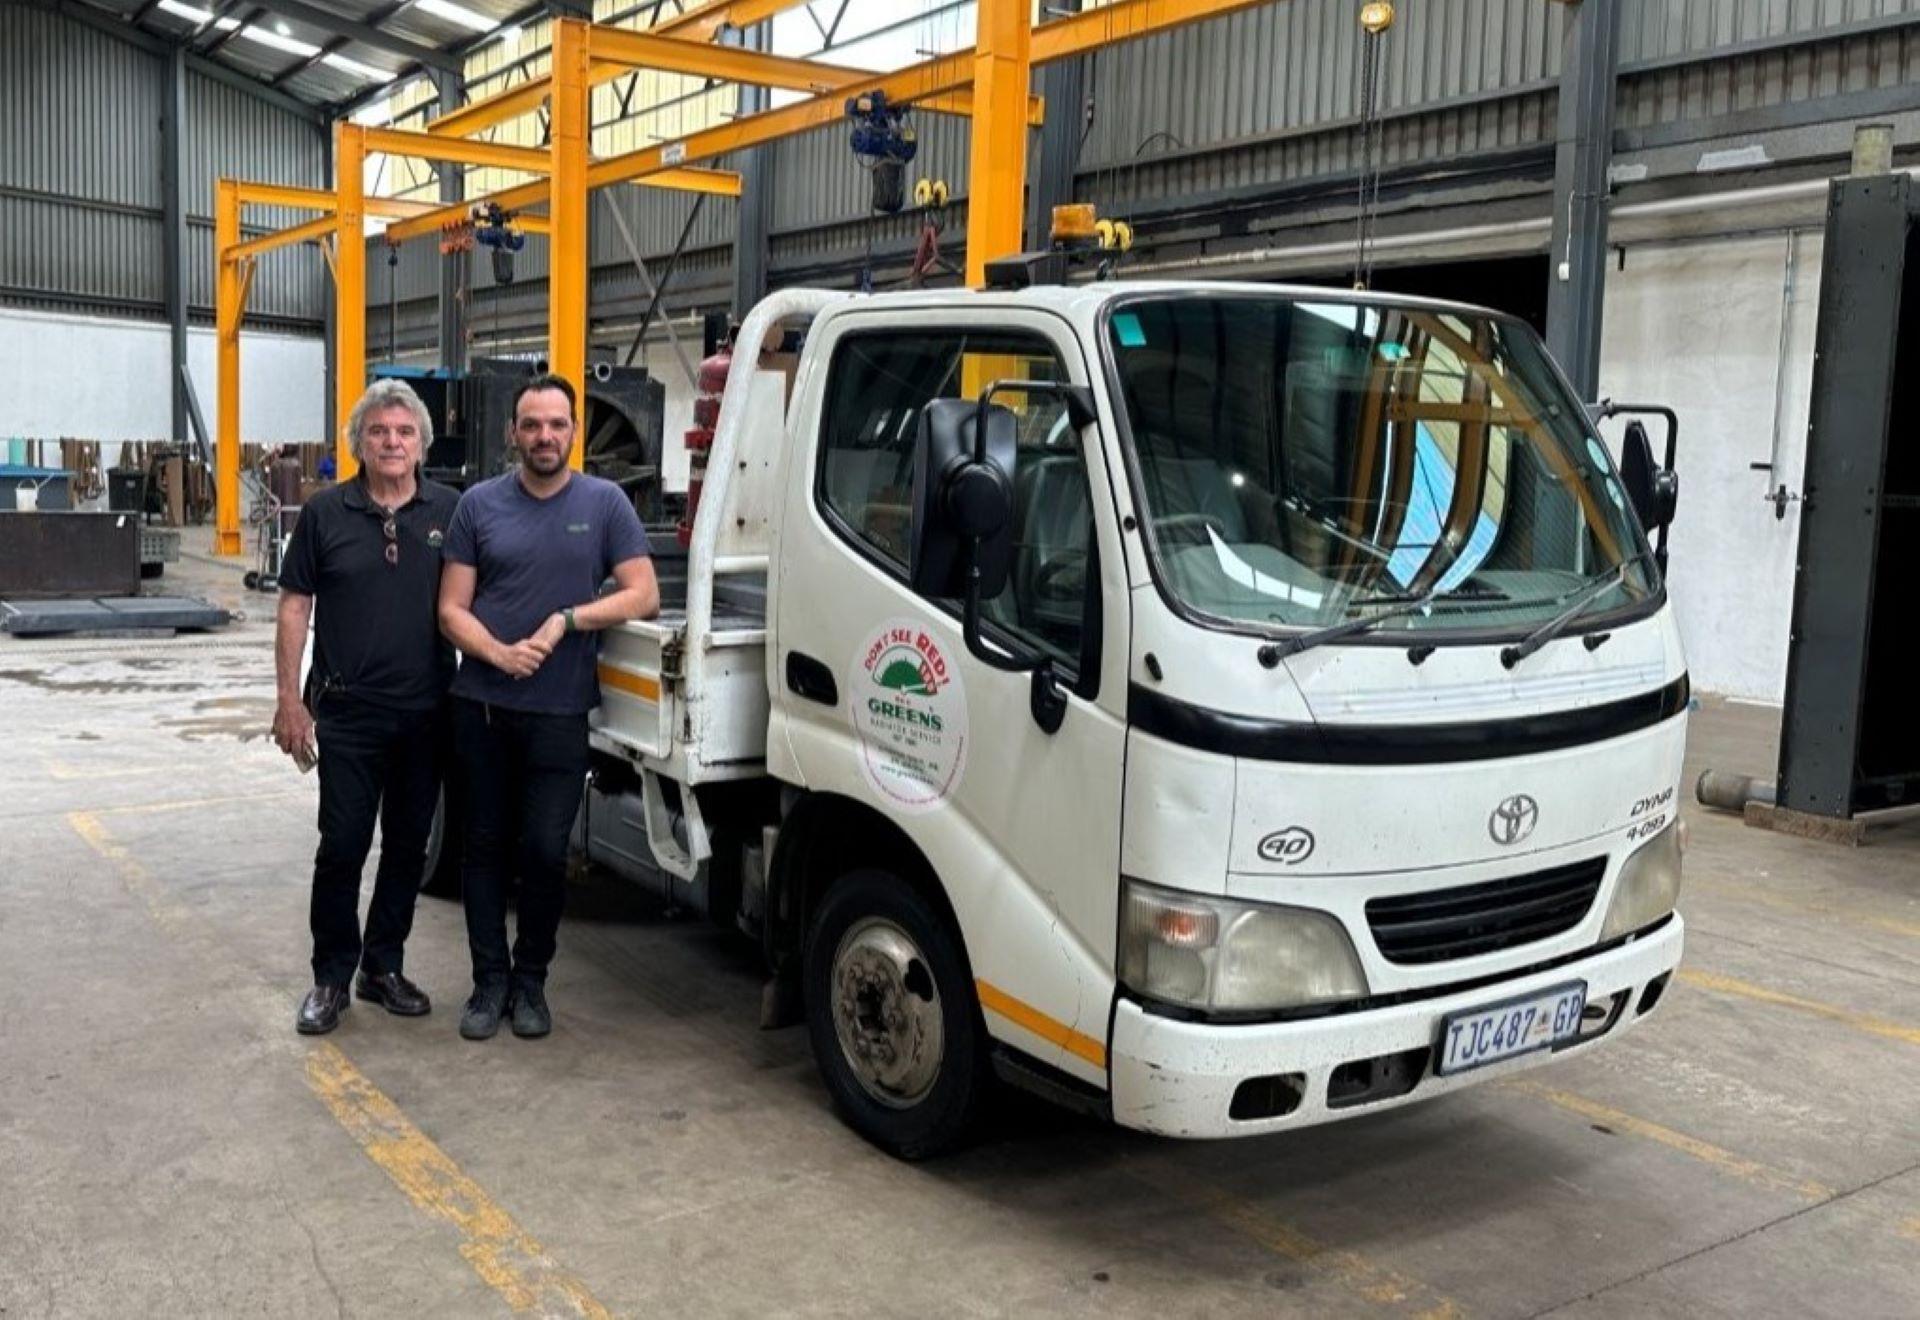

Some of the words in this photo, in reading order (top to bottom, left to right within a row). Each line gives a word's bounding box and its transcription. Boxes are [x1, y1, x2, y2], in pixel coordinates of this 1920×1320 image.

[868, 698, 942, 731] GREEN'S
[1265, 838, 1308, 855] 40
[1450, 1008, 1537, 1062] TJC487
[1553, 995, 1581, 1034] GP
